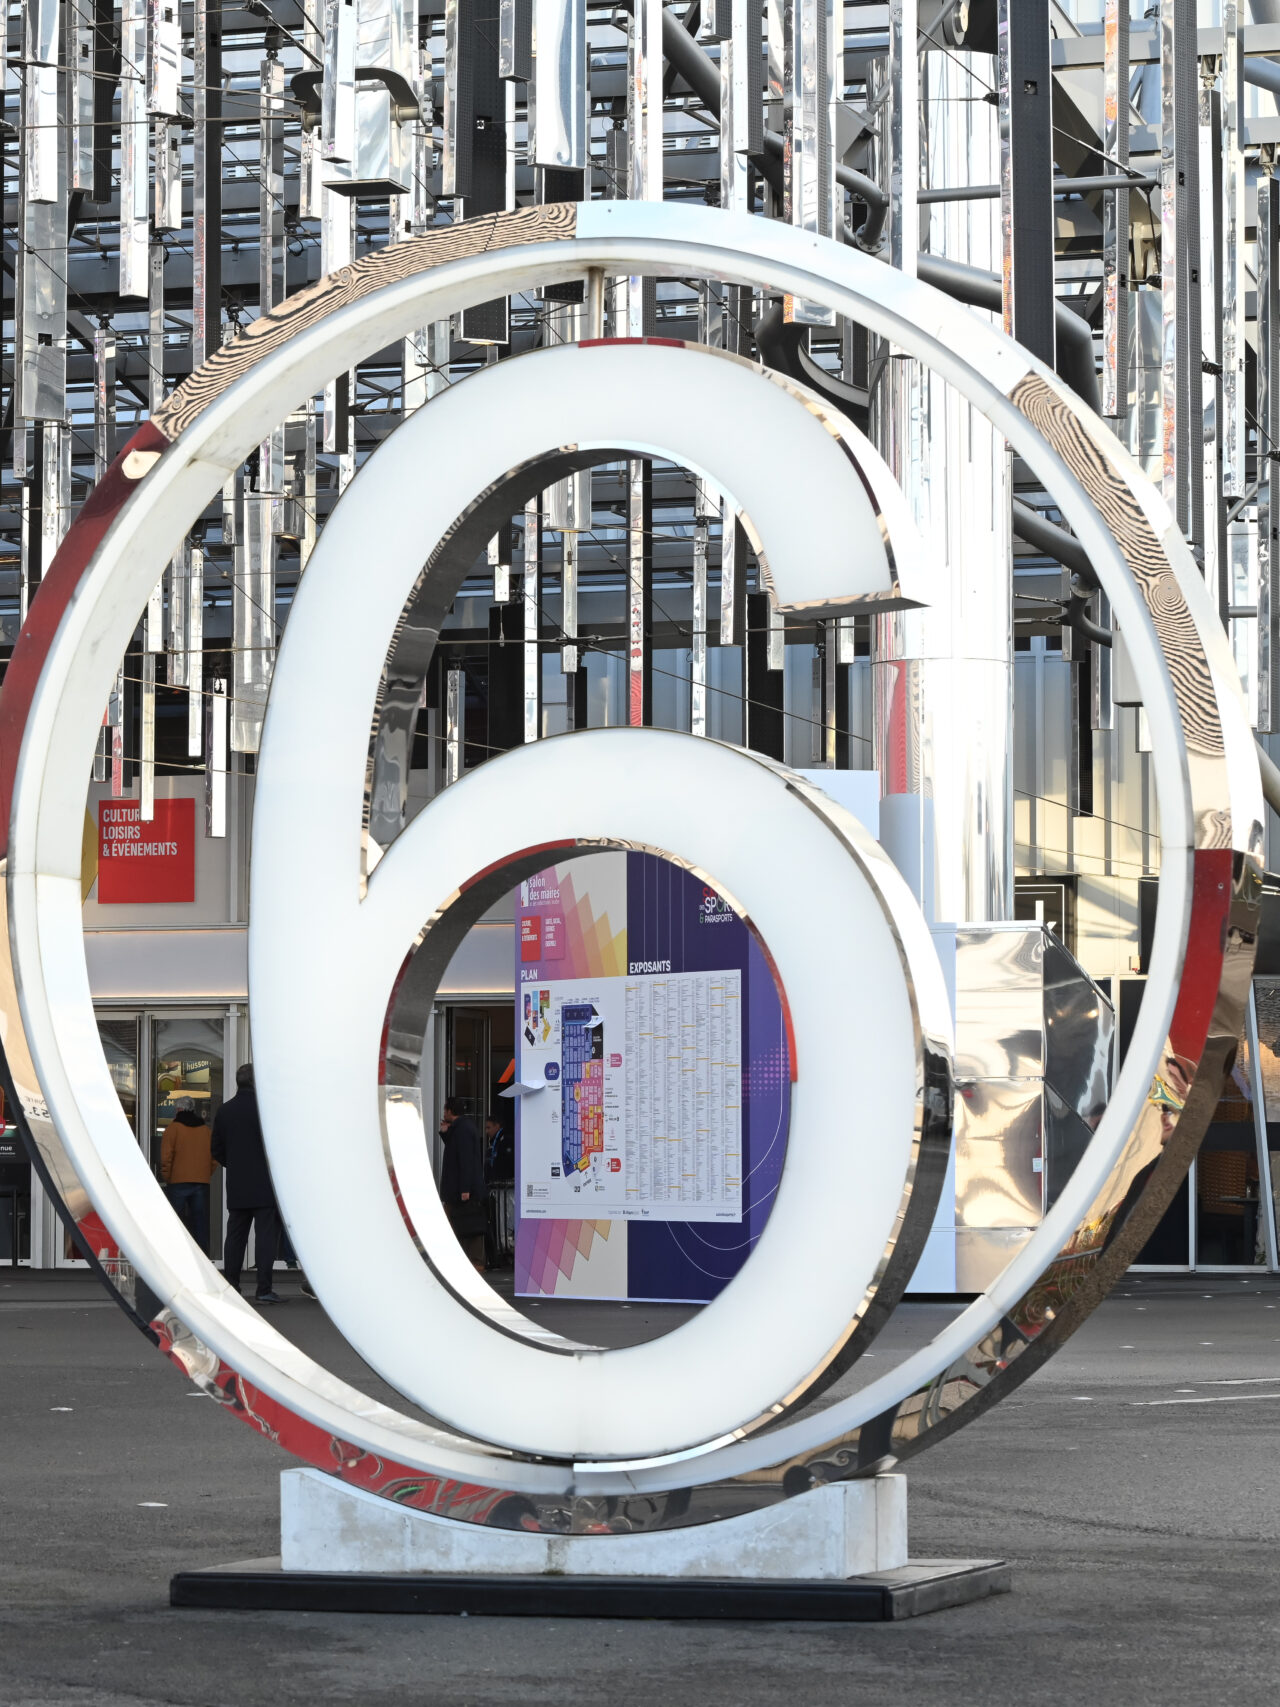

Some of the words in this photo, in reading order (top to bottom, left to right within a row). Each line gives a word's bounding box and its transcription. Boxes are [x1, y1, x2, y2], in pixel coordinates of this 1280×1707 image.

[103, 826, 140, 839] LOISIRS
[103, 844, 109, 856] &
[112, 840, 177, 856] ÉVÉNEMENTS
[529, 877, 546, 888] salon
[530, 890, 539, 900] des
[541, 887, 560, 900] maires
[250, 340, 954, 1464] 6
[705, 914, 733, 923] PARASPORTS
[629, 960, 671, 974] EXPOSANTS
[520, 969, 538, 980] PLAN
